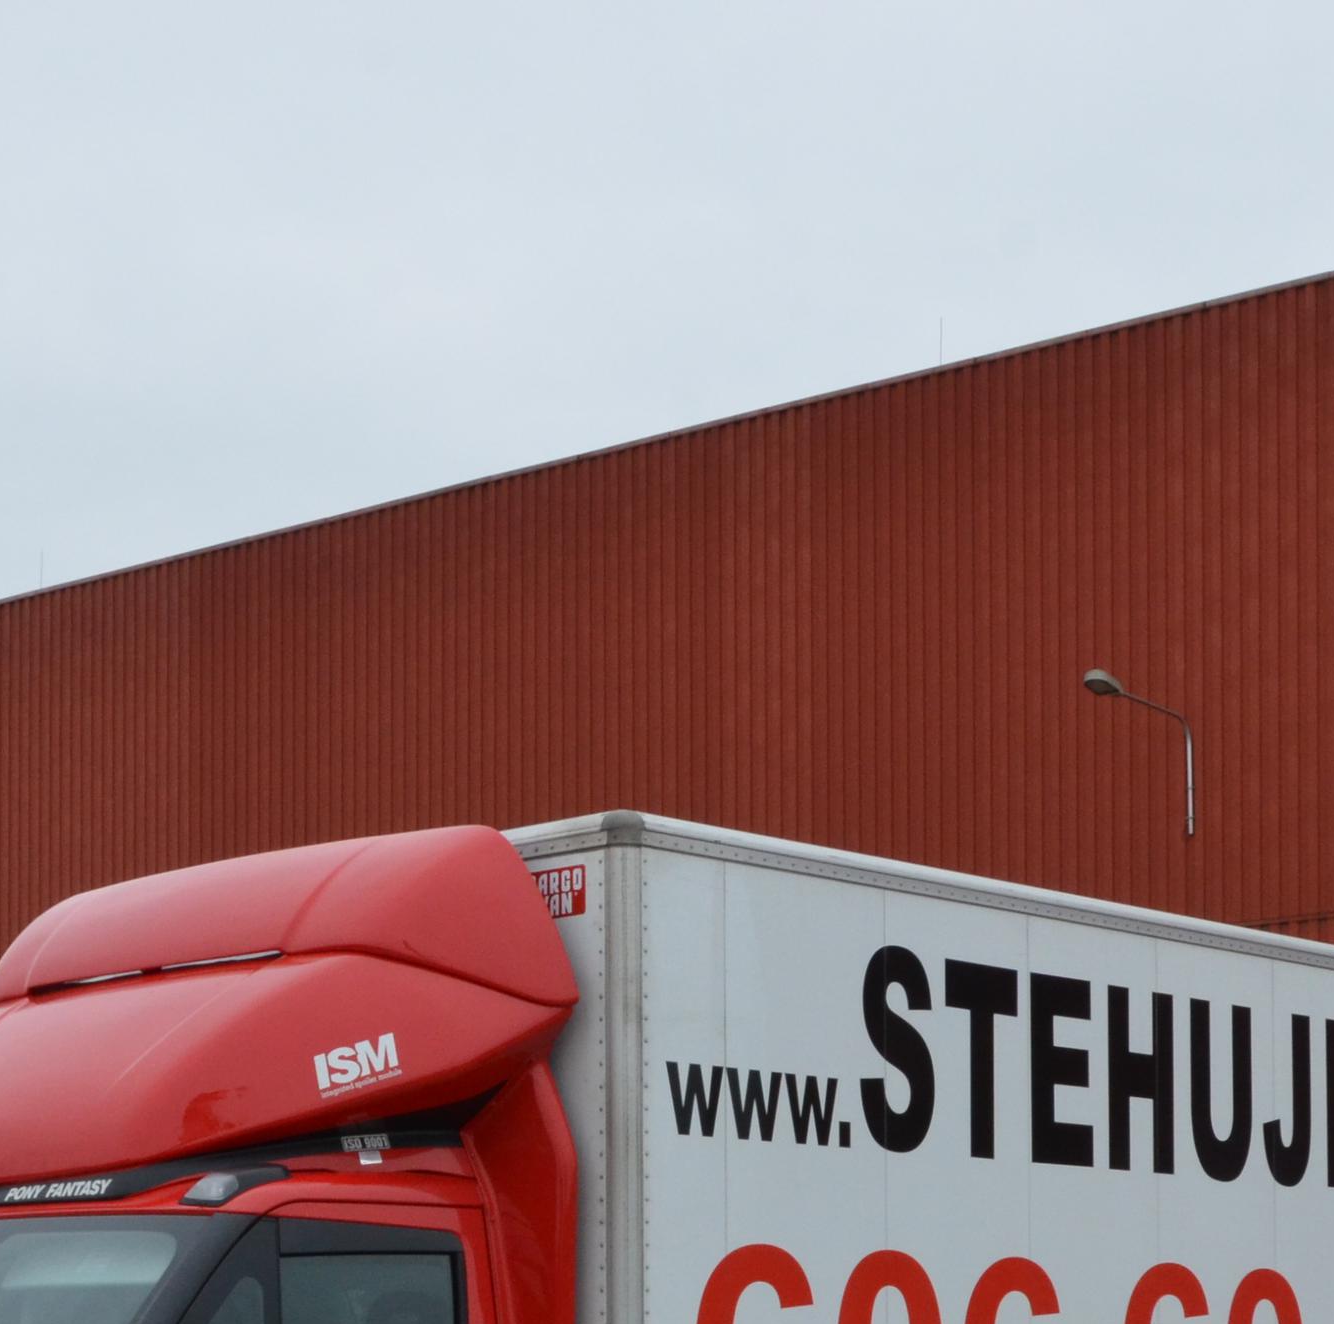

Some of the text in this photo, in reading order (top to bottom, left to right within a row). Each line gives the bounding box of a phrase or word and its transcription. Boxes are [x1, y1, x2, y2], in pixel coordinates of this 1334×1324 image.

[532, 868, 583, 895] ARGO
[545, 891, 573, 916] AN
[313, 1032, 399, 1090] ISM
[4, 1179, 113, 1202] PONY FANTASY
